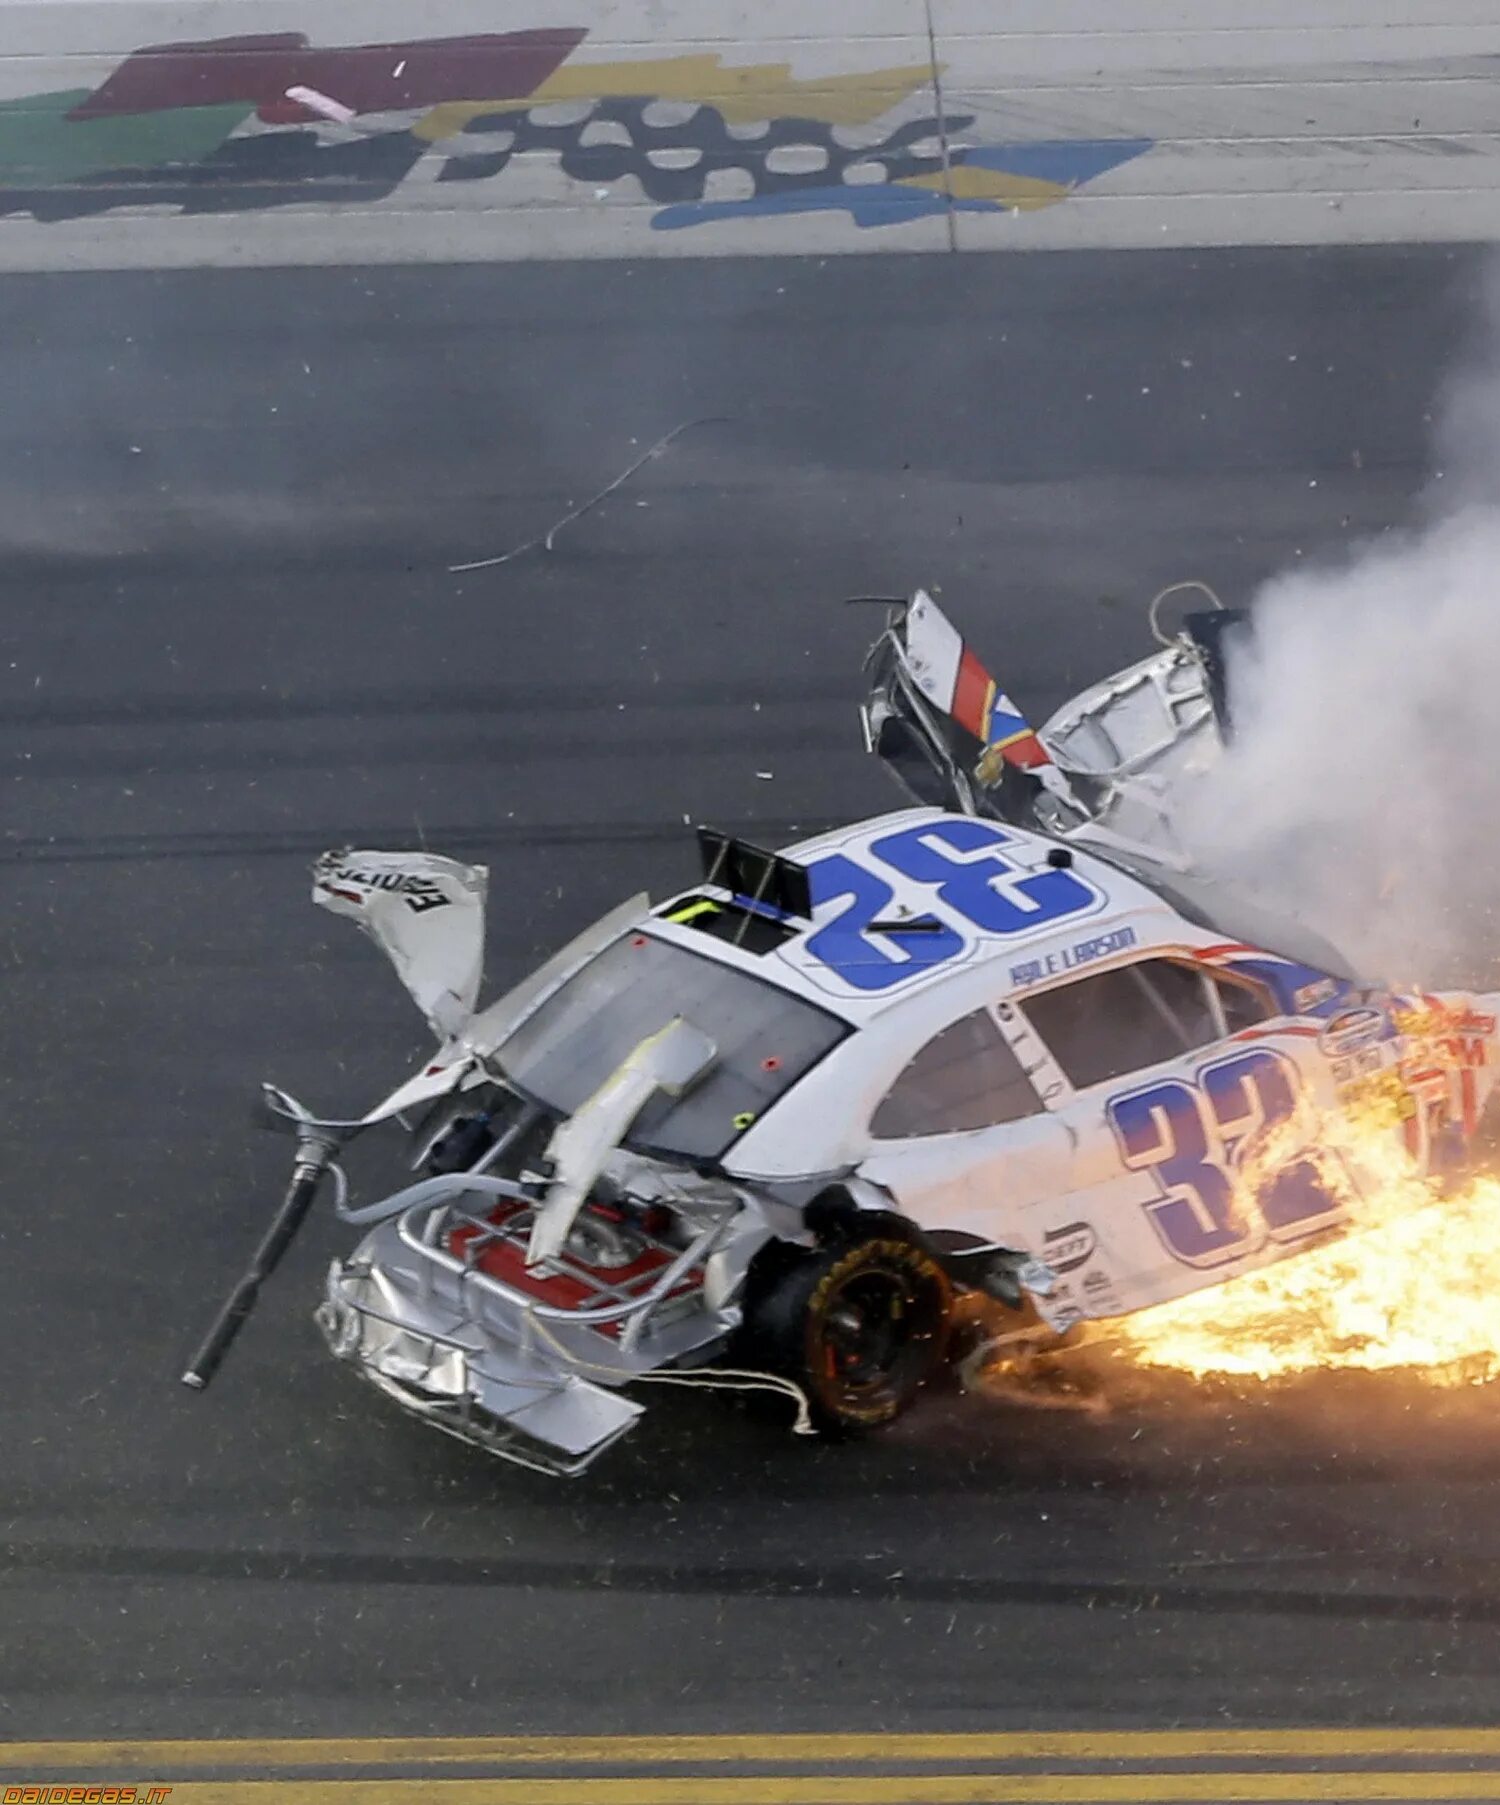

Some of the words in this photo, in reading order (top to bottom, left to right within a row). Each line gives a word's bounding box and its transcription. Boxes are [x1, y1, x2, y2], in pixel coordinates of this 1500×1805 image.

[802, 817, 1099, 993] 32
[1061, 926, 1137, 969] LARSON
[1107, 1048, 1355, 1267] 32
